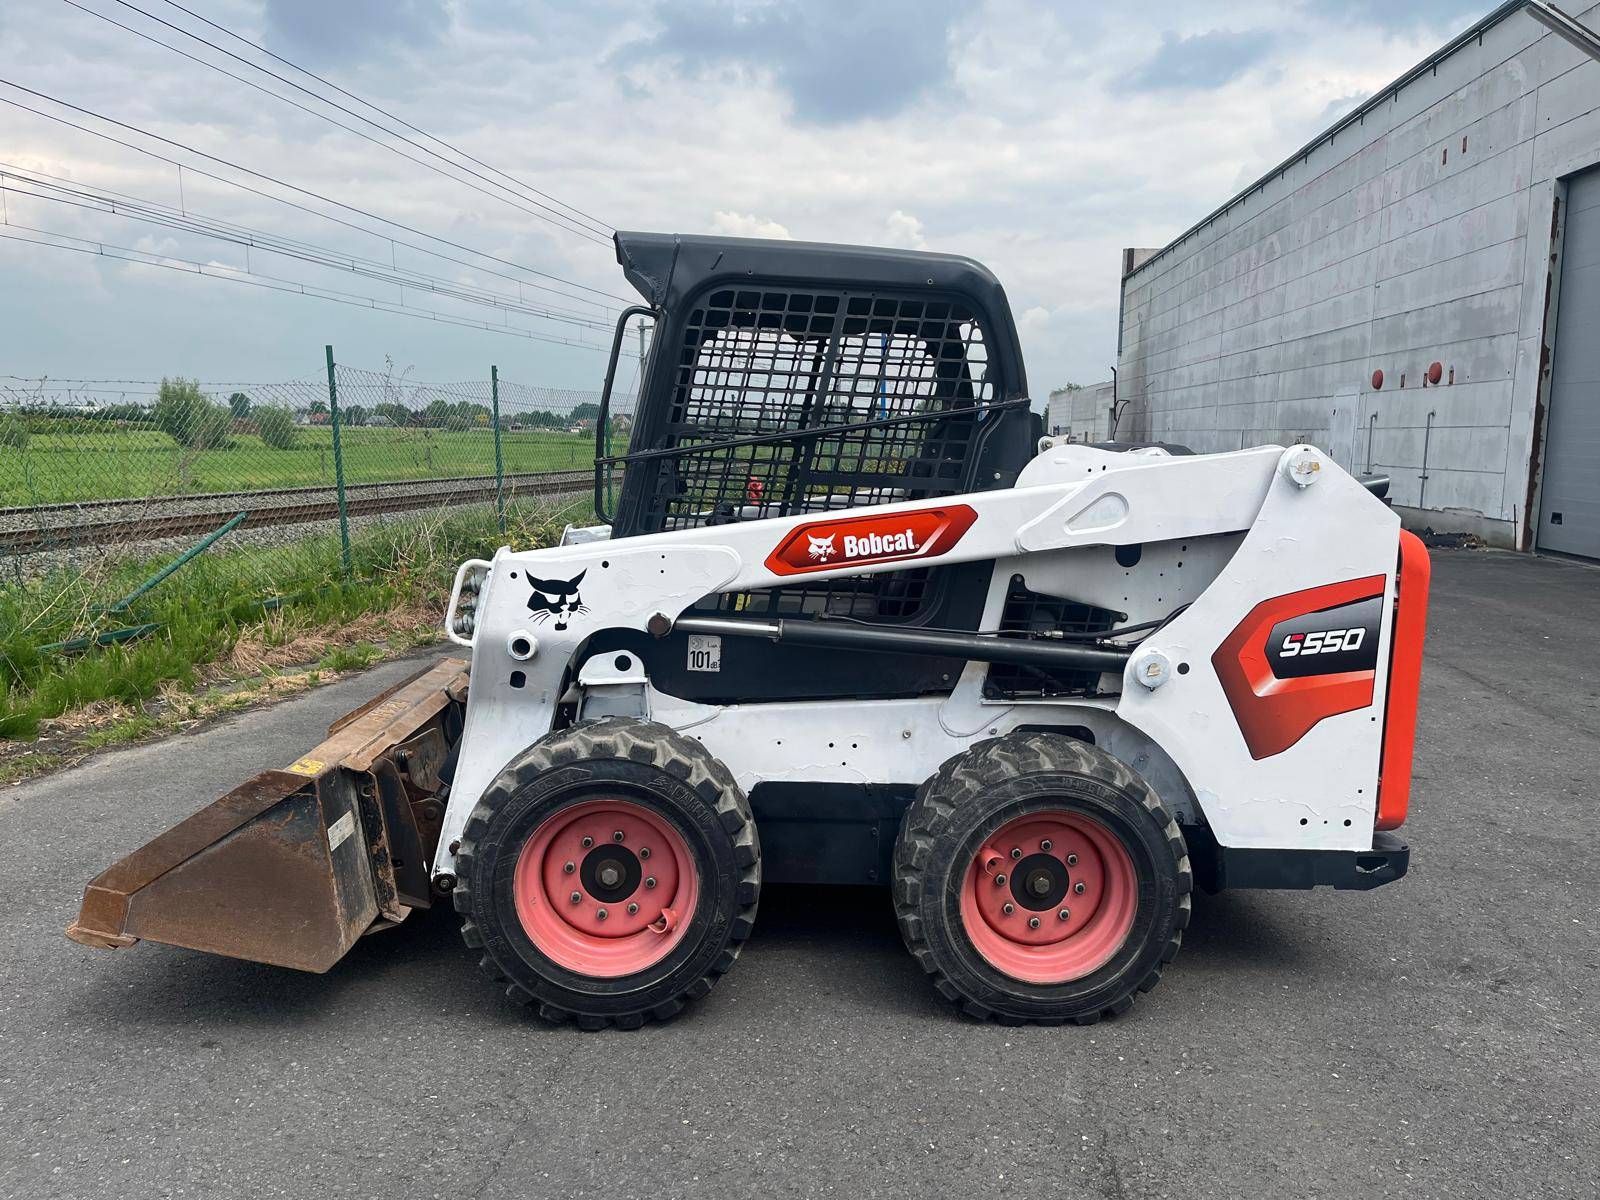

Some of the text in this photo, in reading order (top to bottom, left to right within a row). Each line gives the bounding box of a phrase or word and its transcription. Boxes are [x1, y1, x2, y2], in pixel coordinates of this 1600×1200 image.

[844, 529, 915, 557] Bobcat
[1280, 628, 1366, 657] S550
[690, 650, 710, 668] 101
